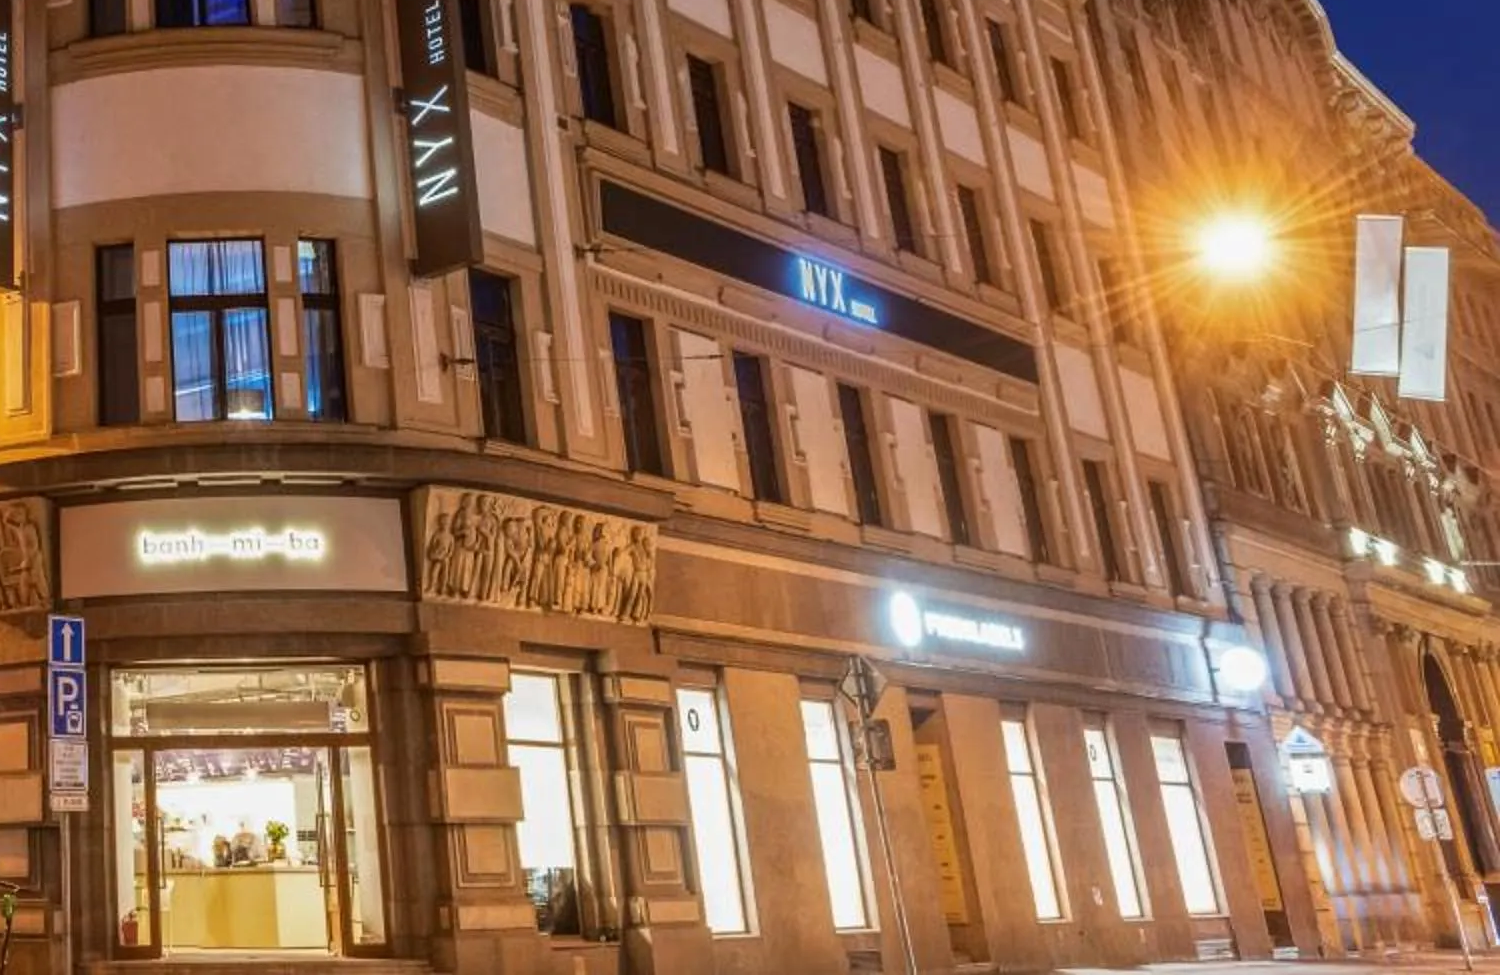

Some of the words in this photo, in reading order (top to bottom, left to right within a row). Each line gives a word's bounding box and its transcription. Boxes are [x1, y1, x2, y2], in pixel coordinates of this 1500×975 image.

[409, 84, 459, 207] NYX
[799, 256, 848, 314] NYX
[57, 676, 79, 716] P
